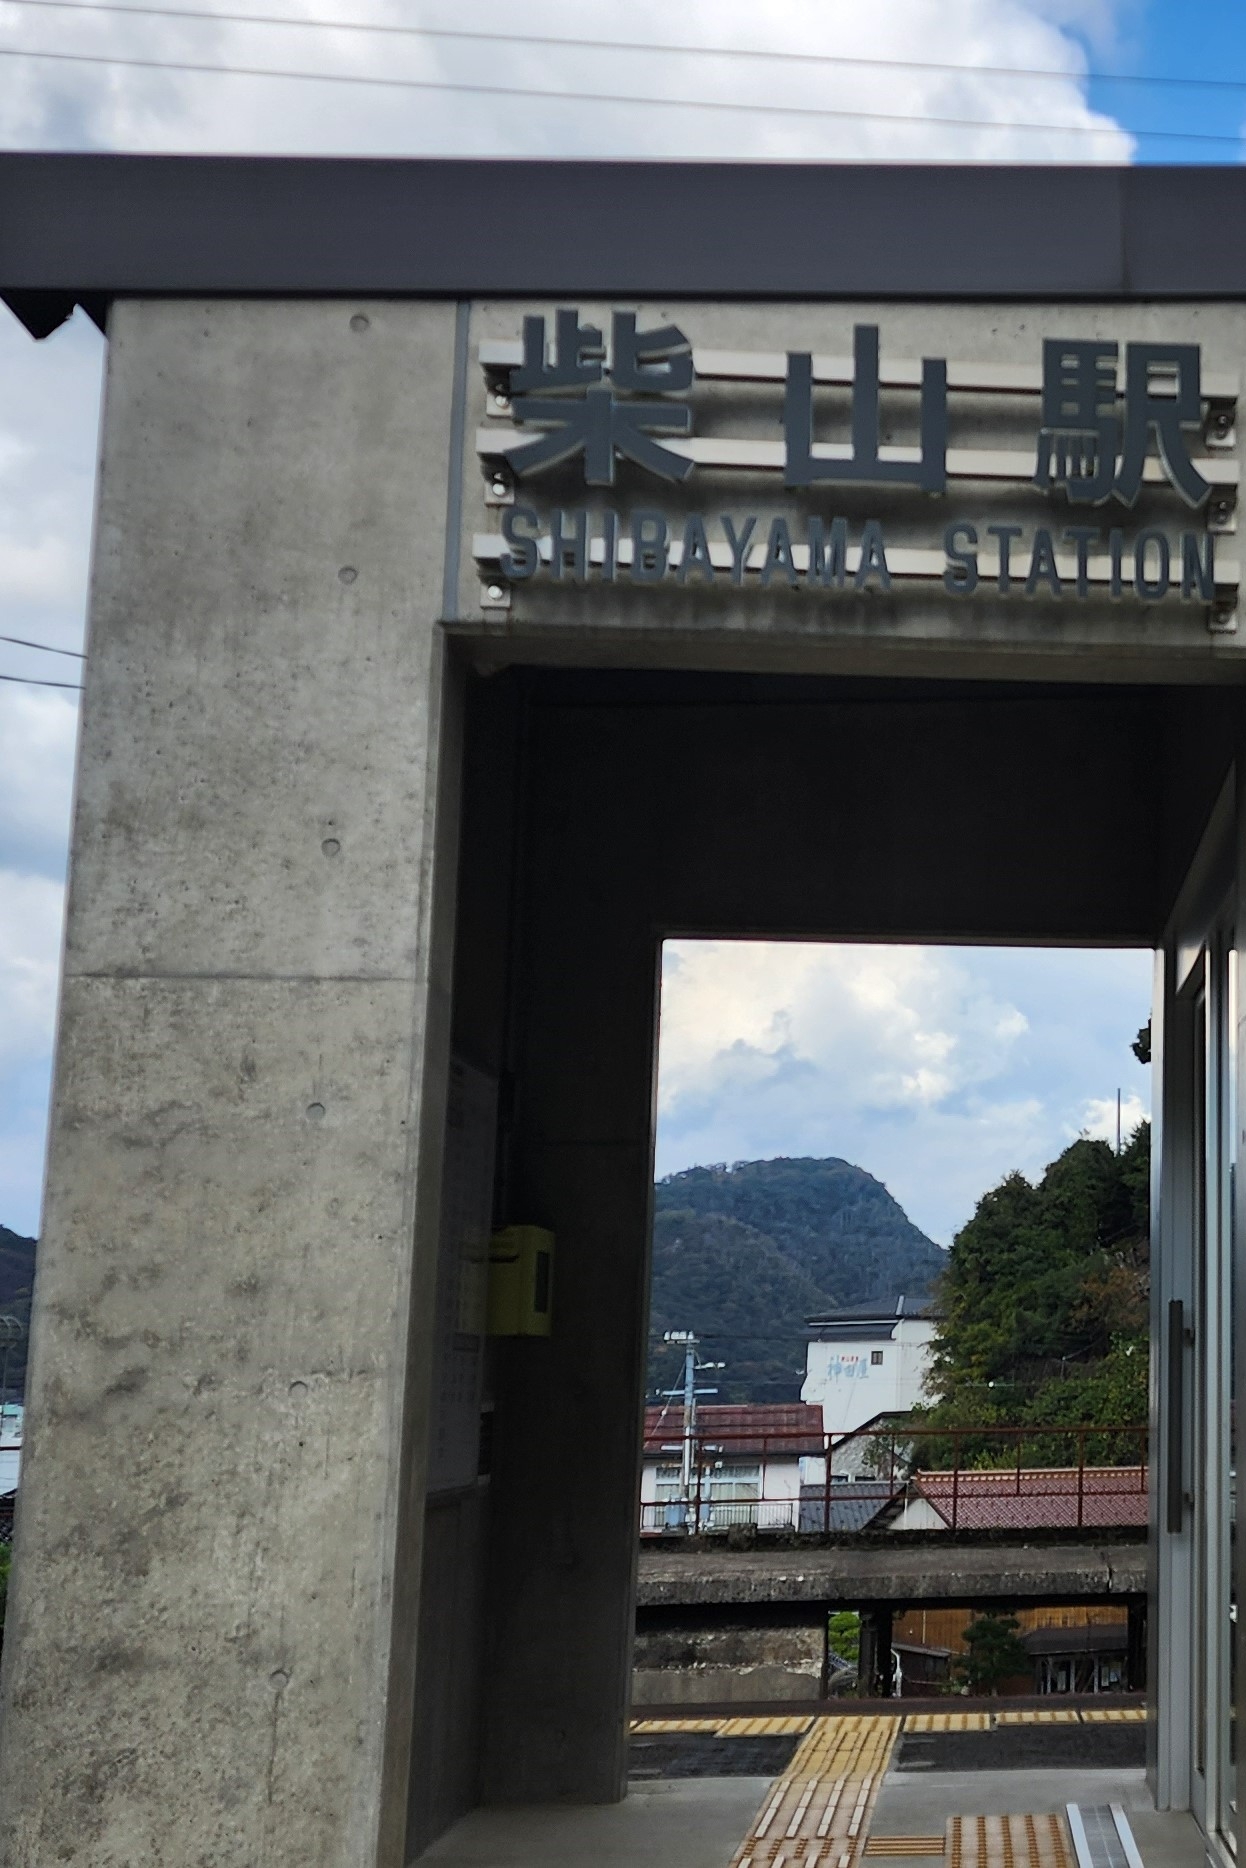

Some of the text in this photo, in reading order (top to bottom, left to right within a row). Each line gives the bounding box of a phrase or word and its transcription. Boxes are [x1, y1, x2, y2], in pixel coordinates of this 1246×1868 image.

[503, 309, 1212, 508] 柴山駅
[499, 507, 1216, 600] SHIBAYAMA STATION
